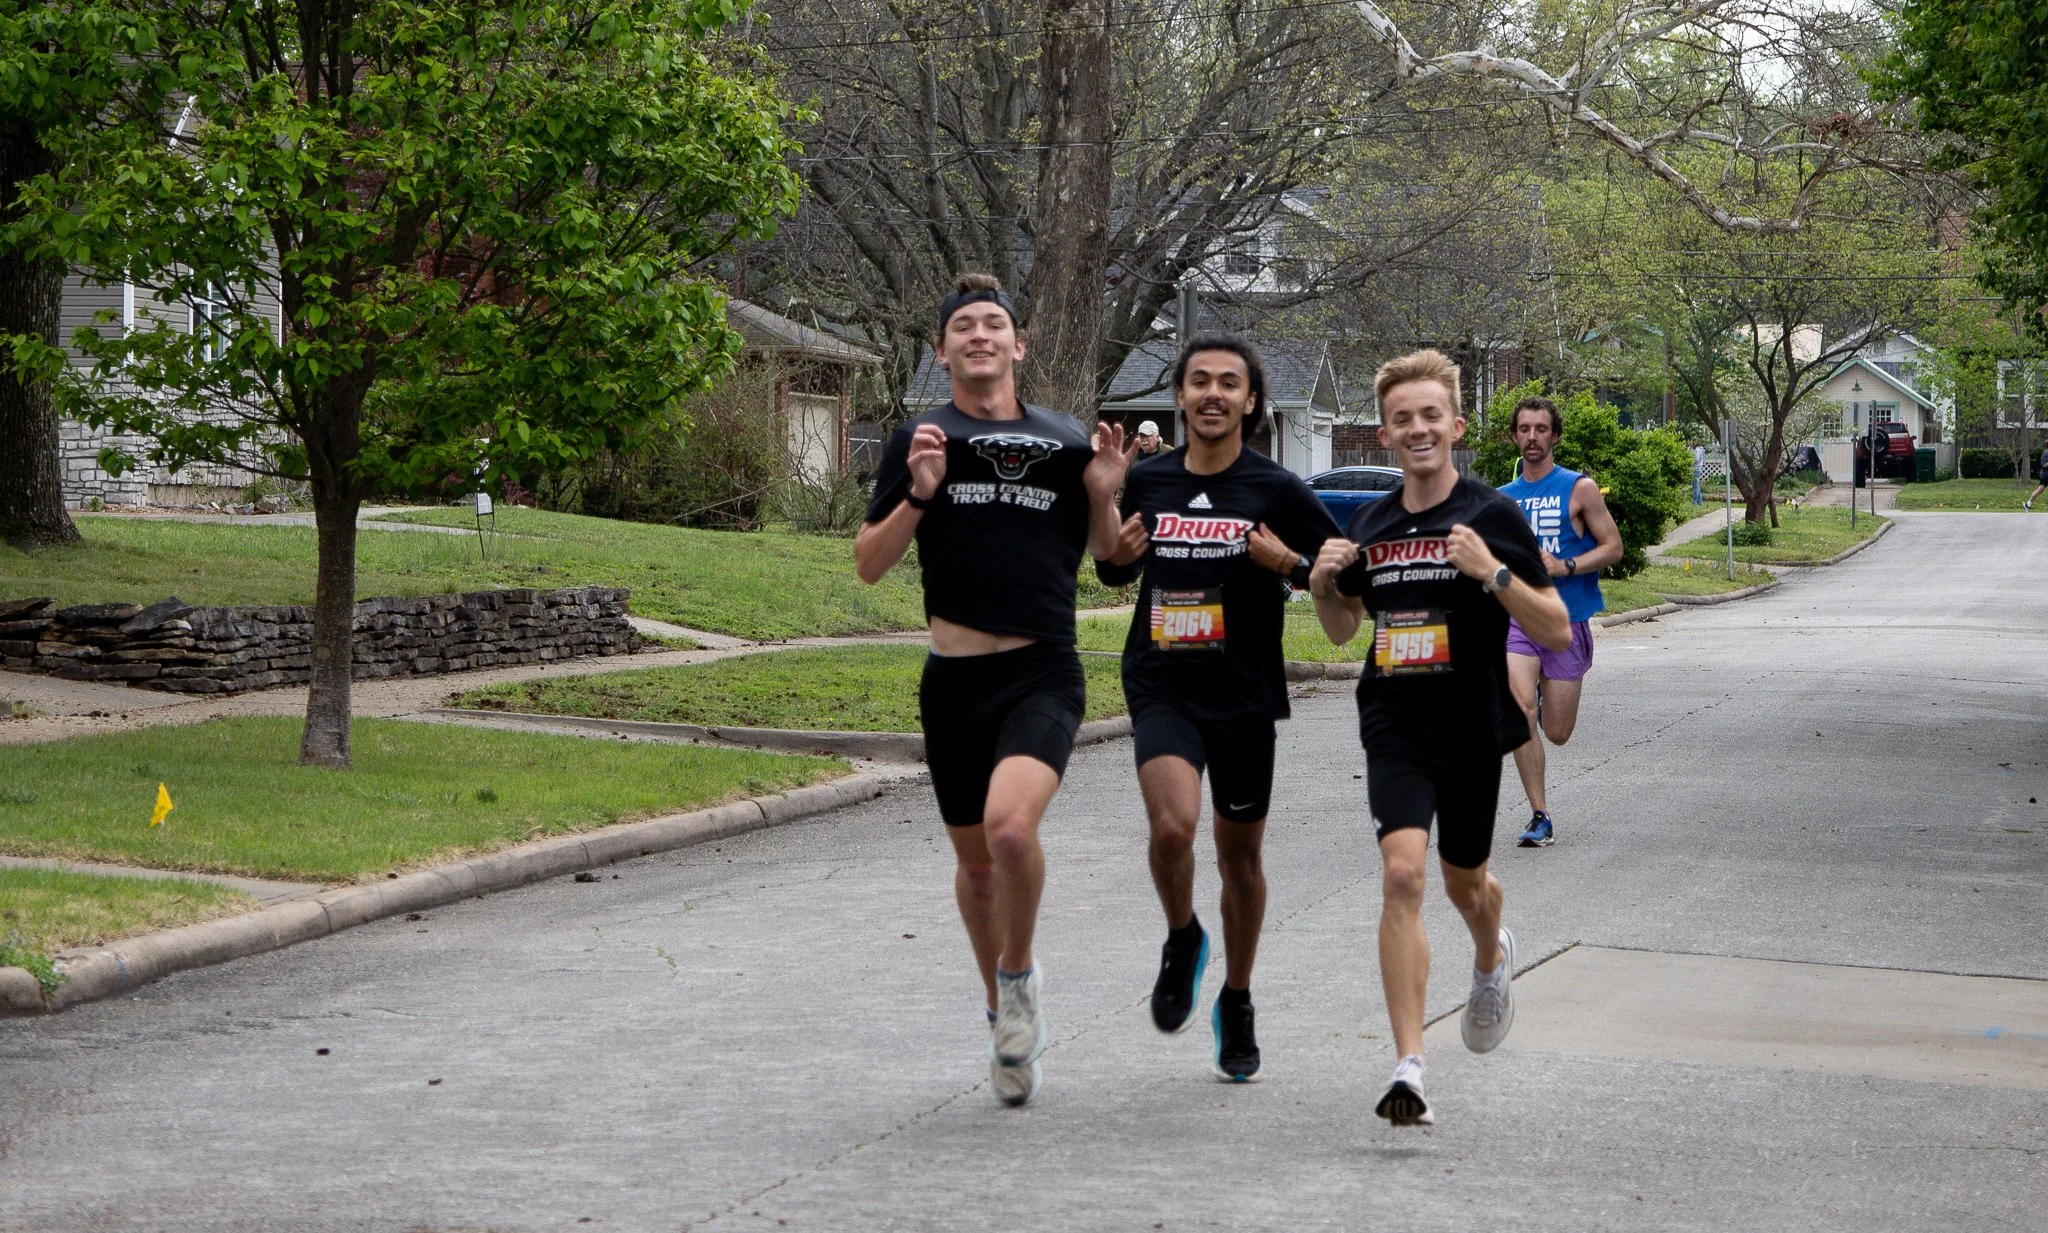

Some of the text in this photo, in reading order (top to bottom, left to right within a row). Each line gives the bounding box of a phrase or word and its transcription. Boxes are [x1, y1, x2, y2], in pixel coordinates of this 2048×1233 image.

[947, 484, 1058, 502] CROSS COUNTRY
[1000, 493, 1011, 503] &
[1015, 495, 1051, 511] FIELD
[1525, 496, 1560, 510] TEAM
[1153, 515, 1252, 543] DRURY
[1155, 543, 1248, 558] CROSS COUNTRY
[1371, 569, 1459, 587] CROSS COUNTRY
[1163, 611, 1212, 637] 2064
[1389, 631, 1435, 661] 1956
